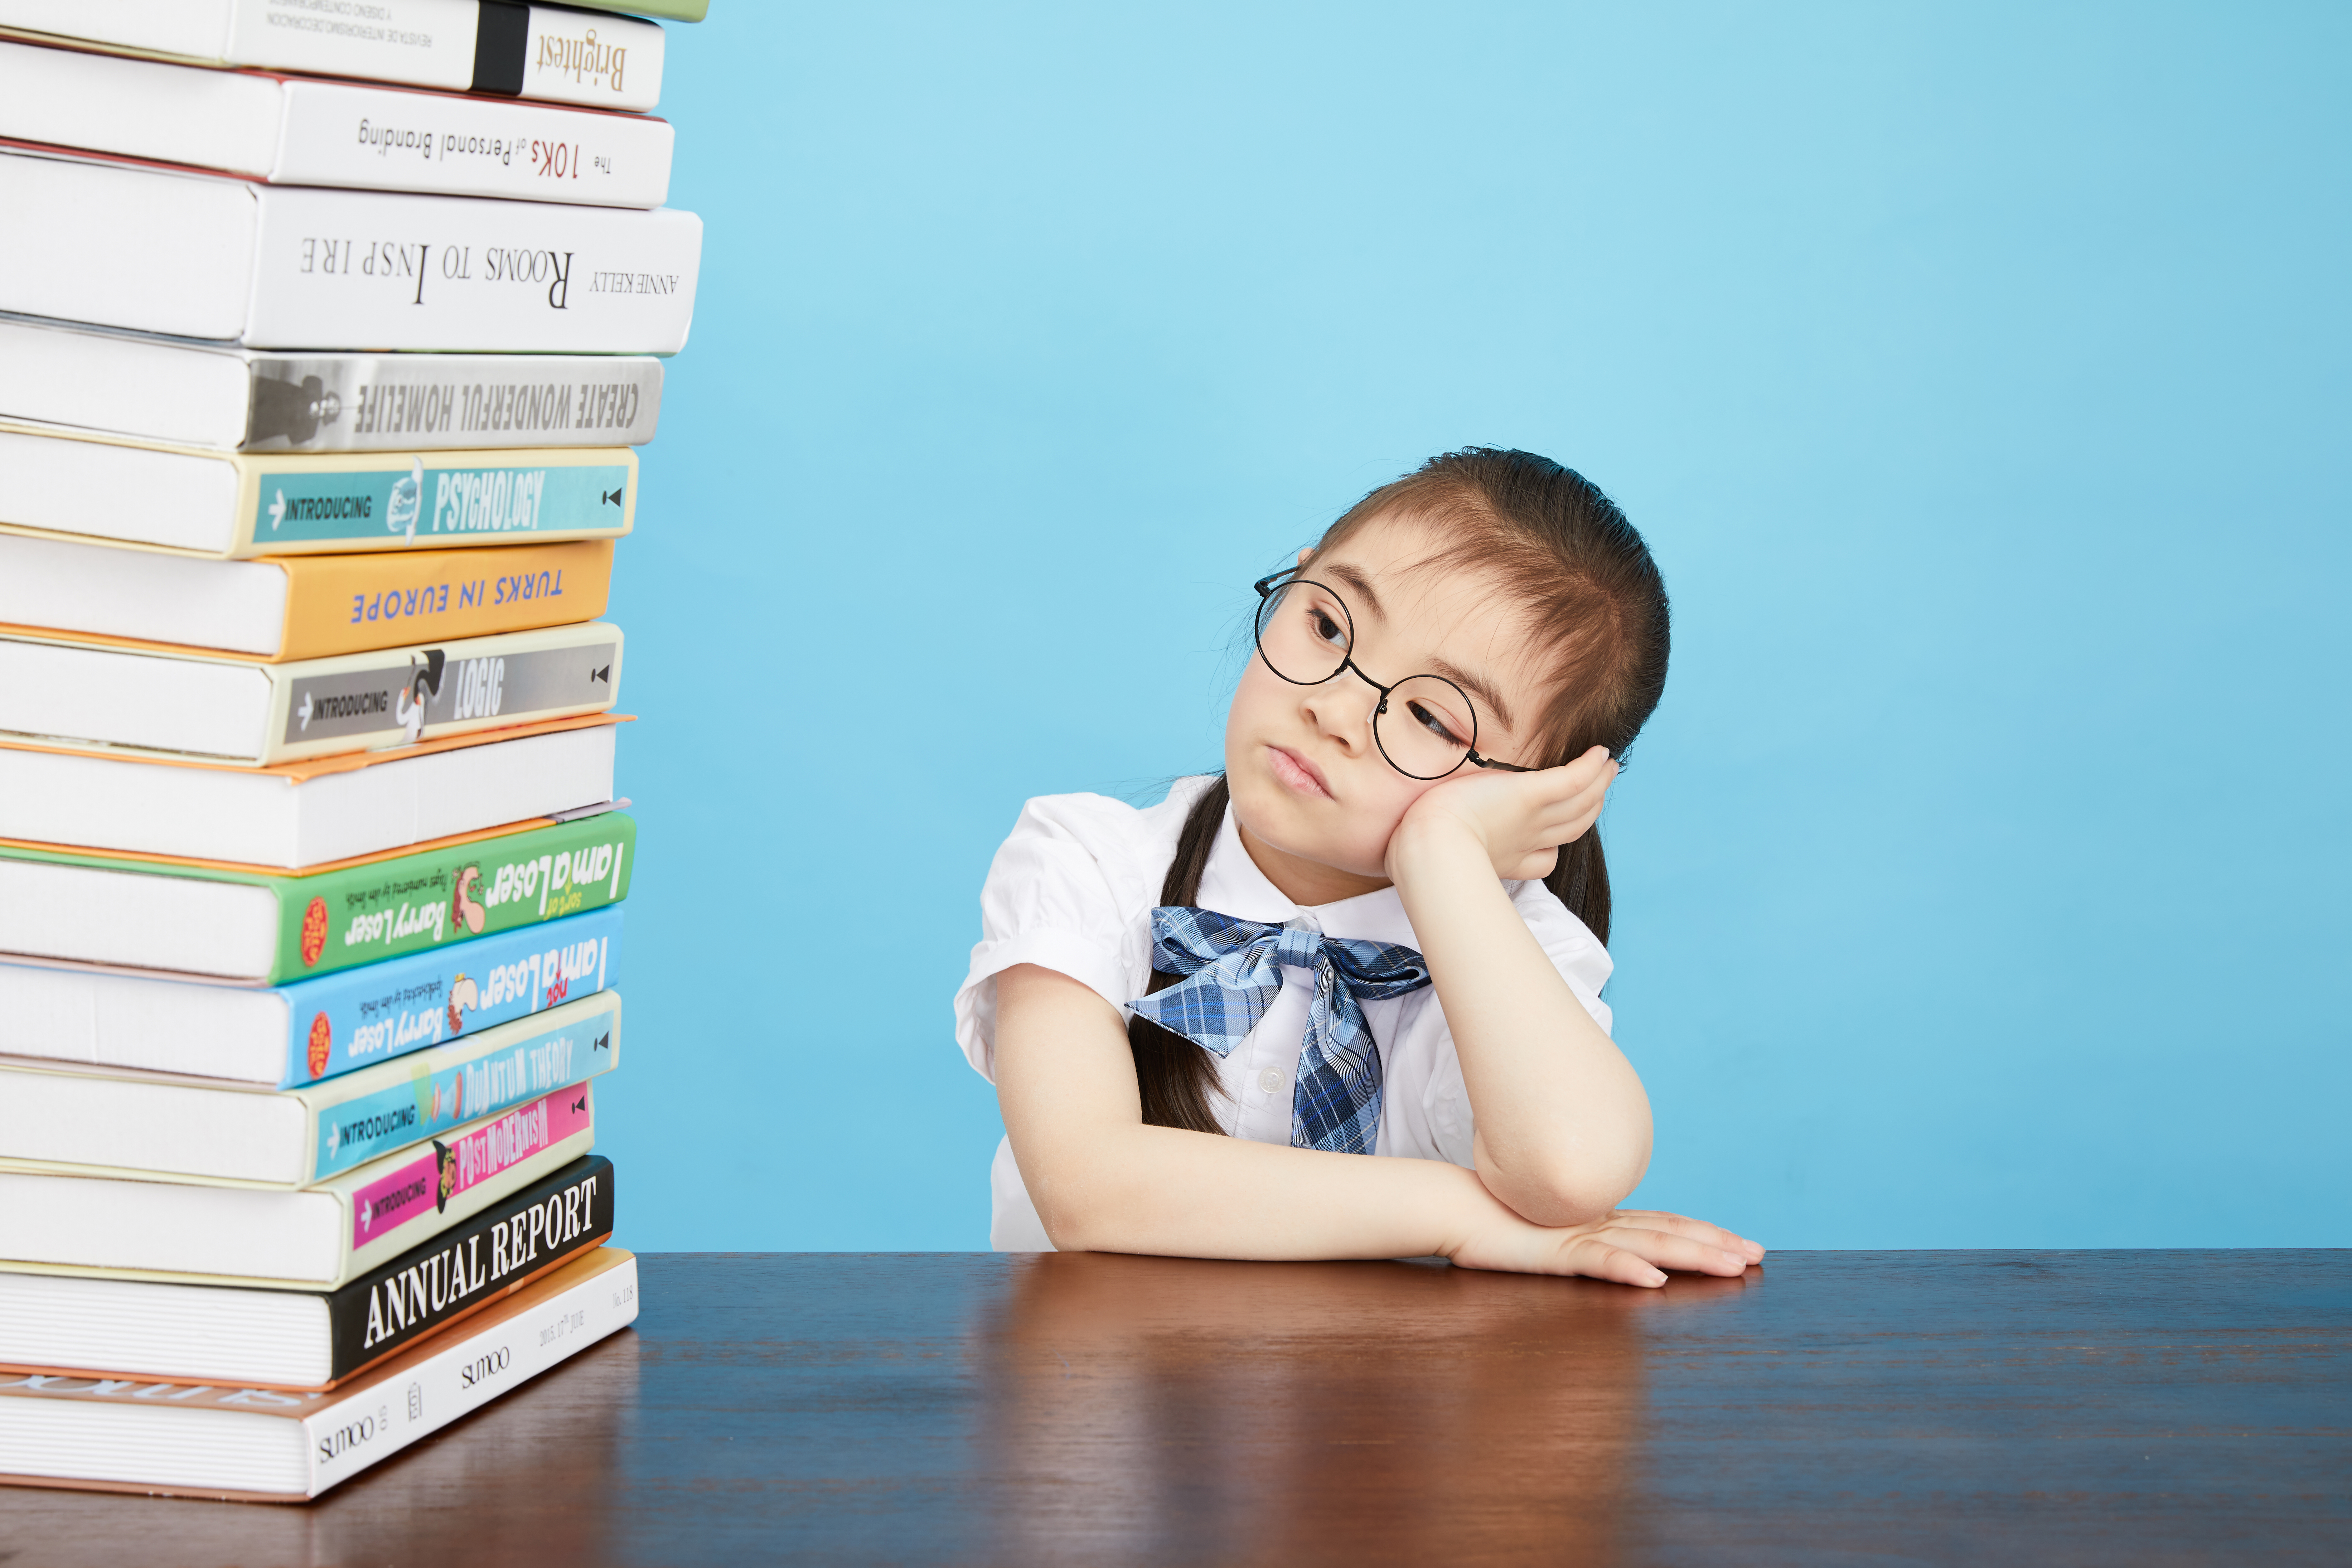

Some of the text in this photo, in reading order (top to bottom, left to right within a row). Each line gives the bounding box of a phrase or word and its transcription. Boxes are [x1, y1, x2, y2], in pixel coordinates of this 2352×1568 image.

[387, 29, 398, 43] DE
[400, 32, 432, 48] REVISTA
[537, 29, 627, 92] Brightest
[359, 119, 611, 179] The 10Ks of Personal Branding
[443, 246, 471, 279] TO
[485, 247, 575, 309] ROOMS
[590, 271, 679, 295] ANNIE KELLY
[354, 383, 639, 434] CREATE WONDERFUL HOMELIFE
[285, 495, 372, 522] INTRODUCING
[351, 569, 563, 624] TURKS IN EUROPE
[313, 691, 388, 721] INTRODUCING
[454, 657, 505, 720] LOGIC
[485, 855, 552, 915] Loser
[559, 892, 582, 916] sort
[345, 909, 394, 947] Loser
[392, 900, 447, 942] Barry
[480, 954, 541, 1013] Loser
[546, 977, 568, 1009] not
[348, 1018, 394, 1058] Loser
[394, 1006, 444, 1047] Barry
[464, 1037, 573, 1120] QUANTUM THEORY
[339, 1104, 415, 1149] INTRODUCING
[459, 1098, 548, 1190] POSTMODERNISM
[372, 1177, 426, 1221] INTRODUCING
[364, 1176, 596, 1349] ANNUAL REPORT
[613, 1285, 633, 1309] No. 118
[570, 1310, 584, 1334] JUNE
